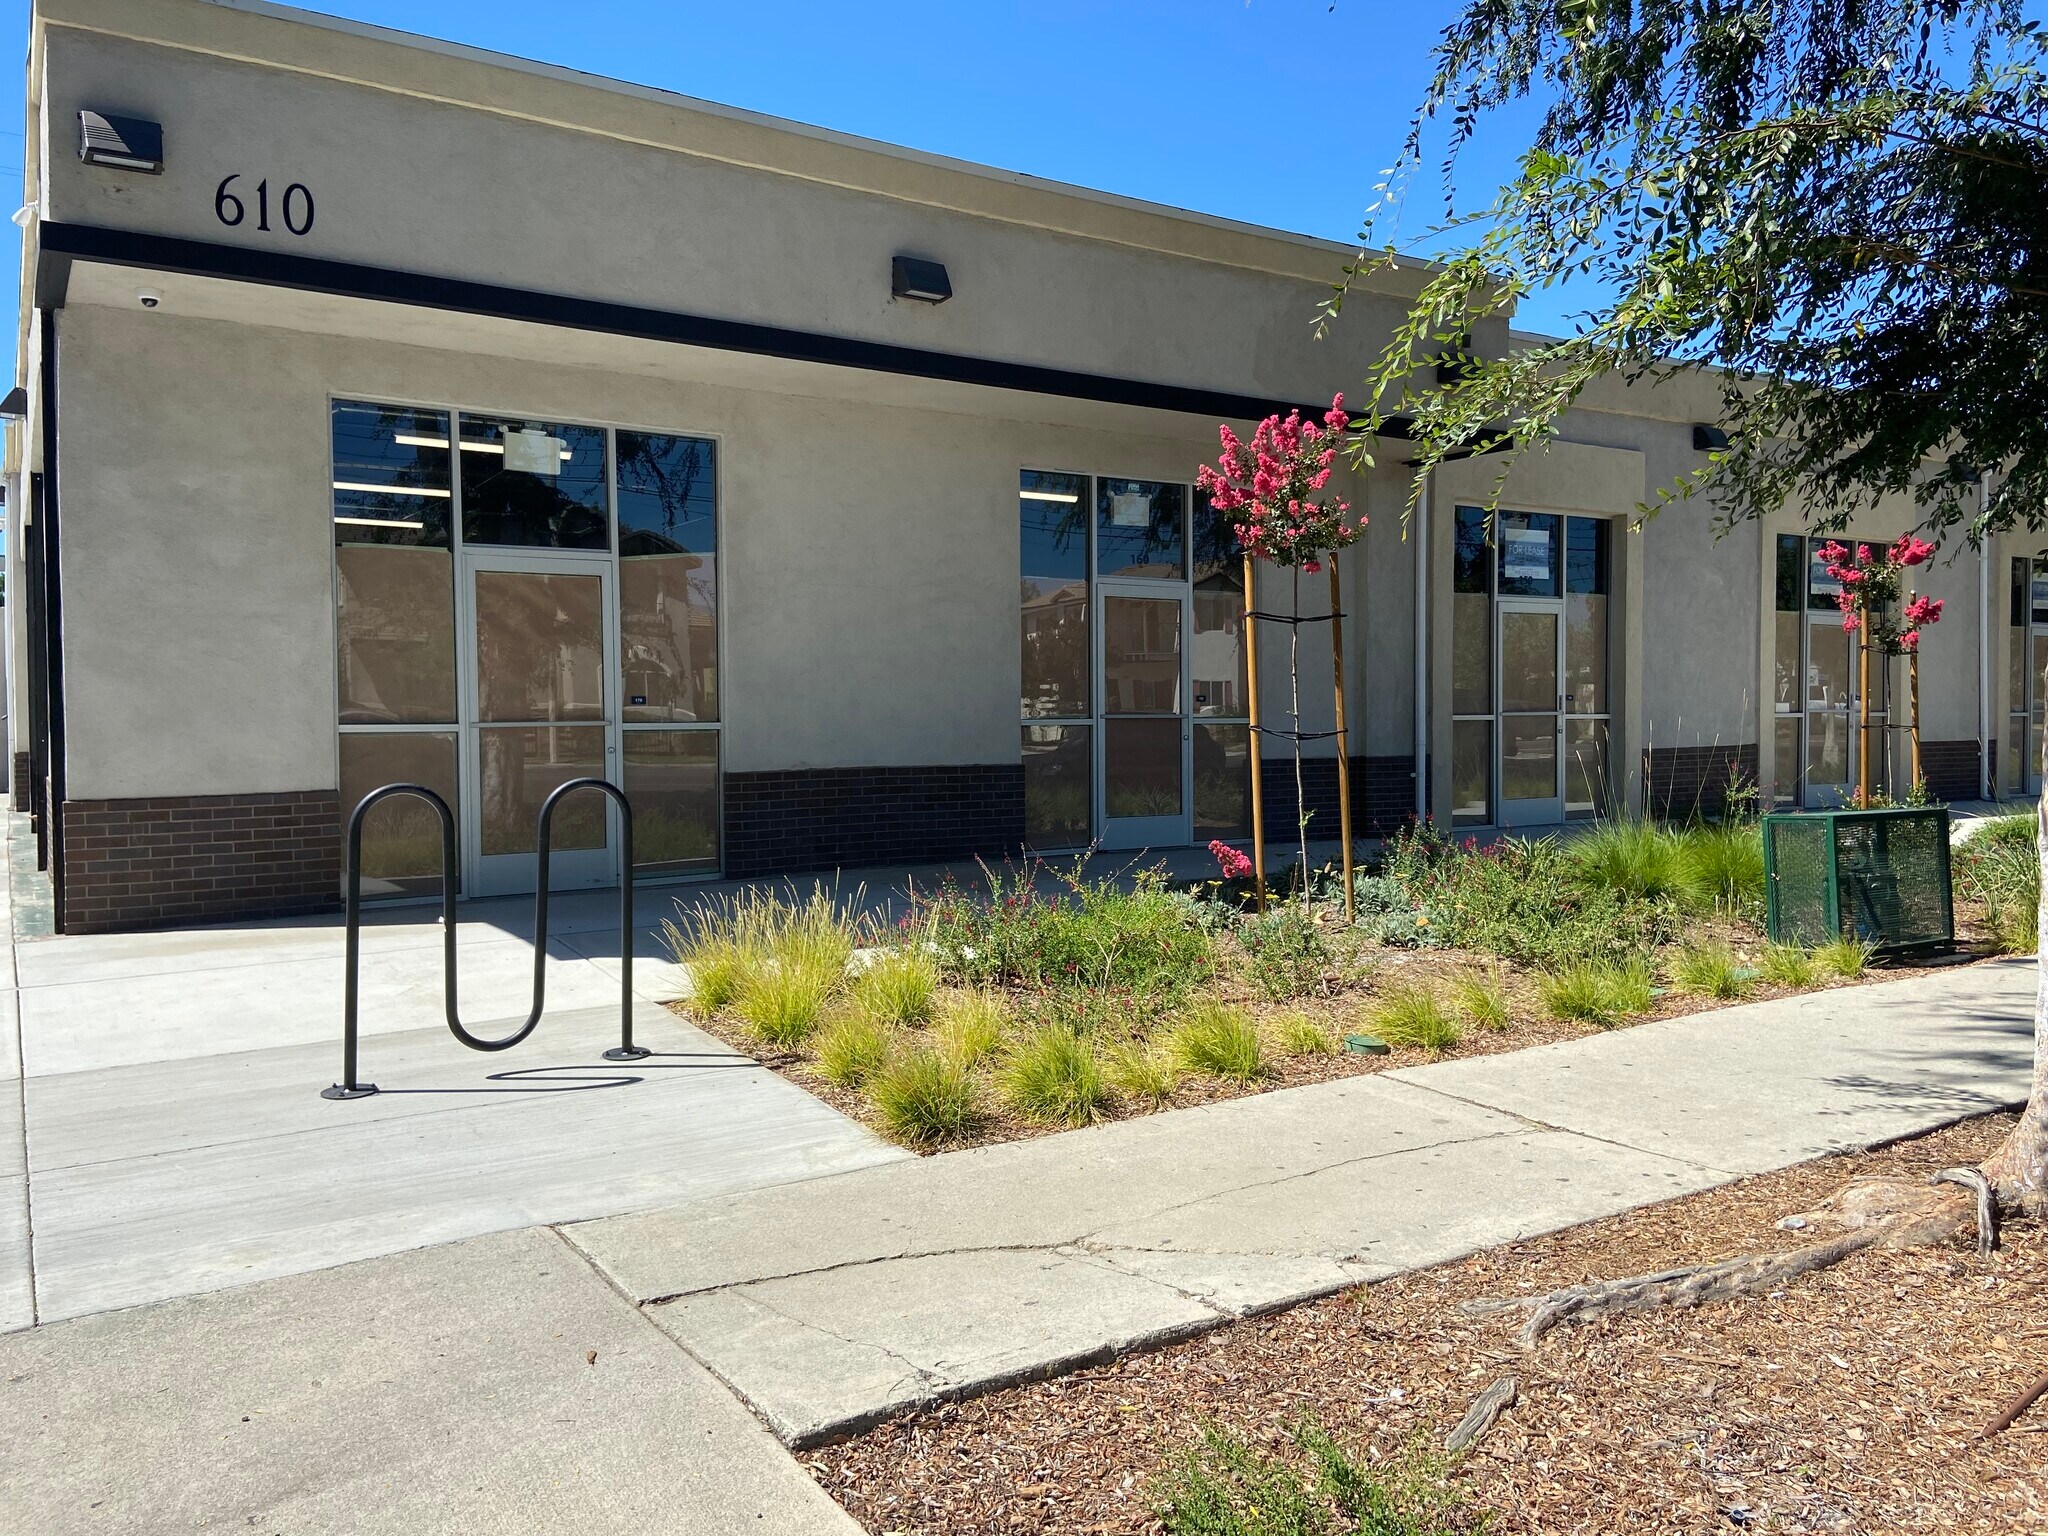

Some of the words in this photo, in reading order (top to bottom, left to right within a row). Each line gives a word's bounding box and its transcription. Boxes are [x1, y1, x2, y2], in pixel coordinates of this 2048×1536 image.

[215, 174, 315, 236] 610
[1508, 545, 1522, 554] FOR
[1524, 545, 1545, 556] LEASE
[1130, 554, 1149, 564] 160
